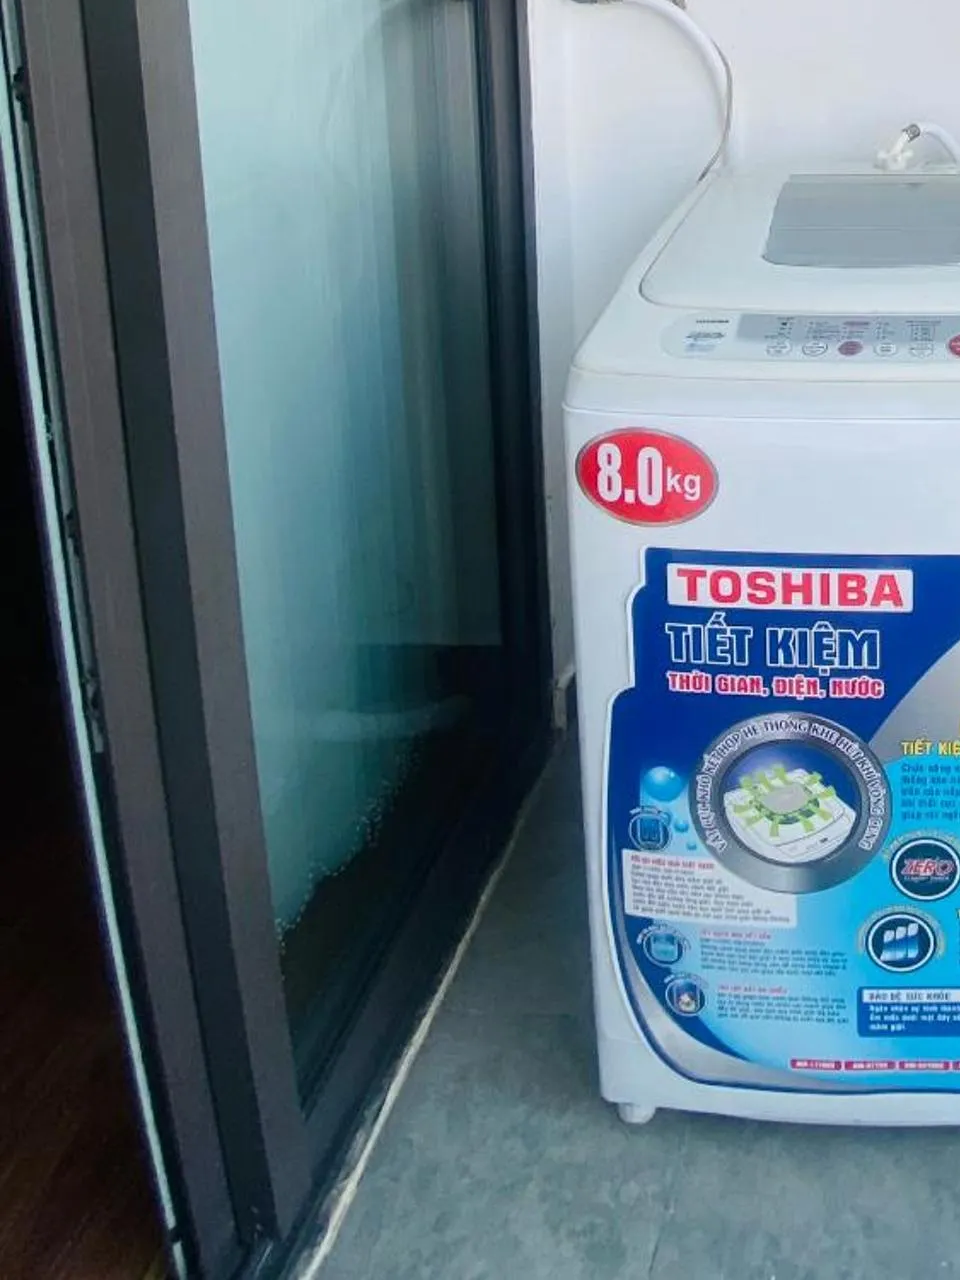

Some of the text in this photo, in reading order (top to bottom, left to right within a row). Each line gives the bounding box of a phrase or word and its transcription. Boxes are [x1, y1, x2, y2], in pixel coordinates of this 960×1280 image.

[676, 567, 904, 607] TOSHIBA
[665, 611, 881, 677] TIẾT KIỆM
[667, 670, 712, 694] THỜI
[716, 675, 769, 697] GIAN,
[773, 674, 827, 700] ĐIỆN,
